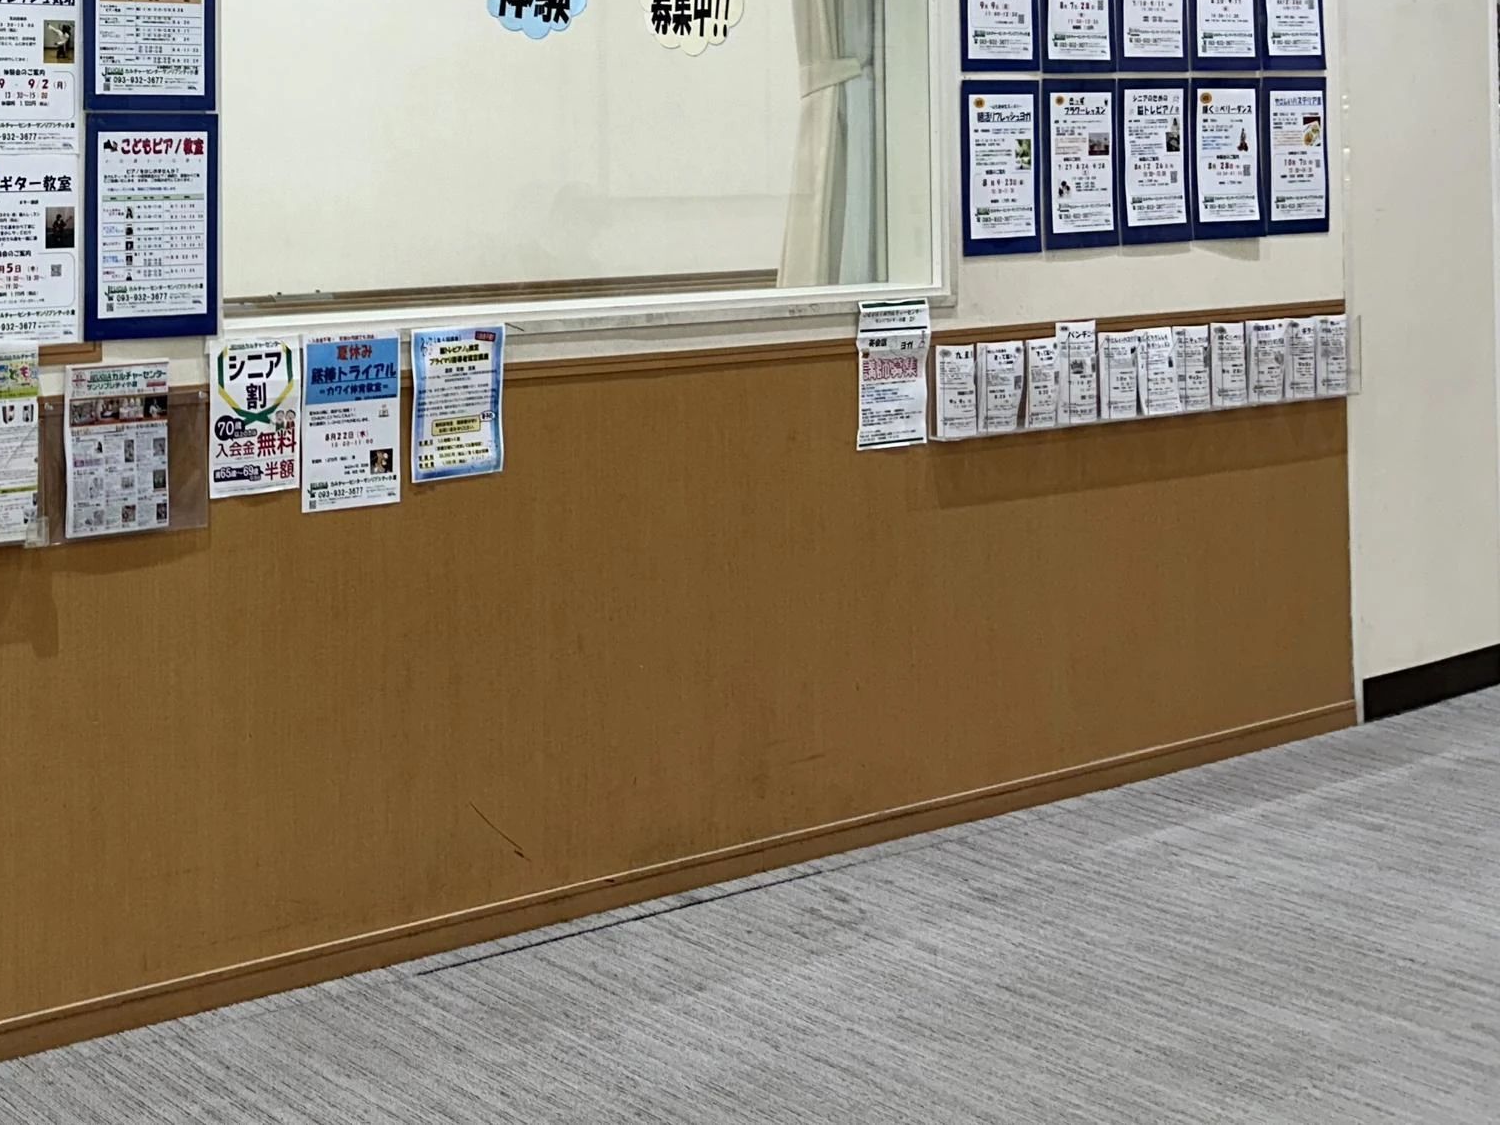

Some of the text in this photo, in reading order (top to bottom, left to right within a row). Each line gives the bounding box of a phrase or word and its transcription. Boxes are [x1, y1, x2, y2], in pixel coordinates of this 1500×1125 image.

[121, 138, 204, 156] こどもピアノ教室
[0, 175, 73, 192] ギター教室
[336, 345, 373, 361] 夏休み
[228, 352, 282, 381] シニア
[245, 382, 267, 410] 割
[216, 428, 297, 459] 入会金 無料
[264, 459, 296, 481] 半額
